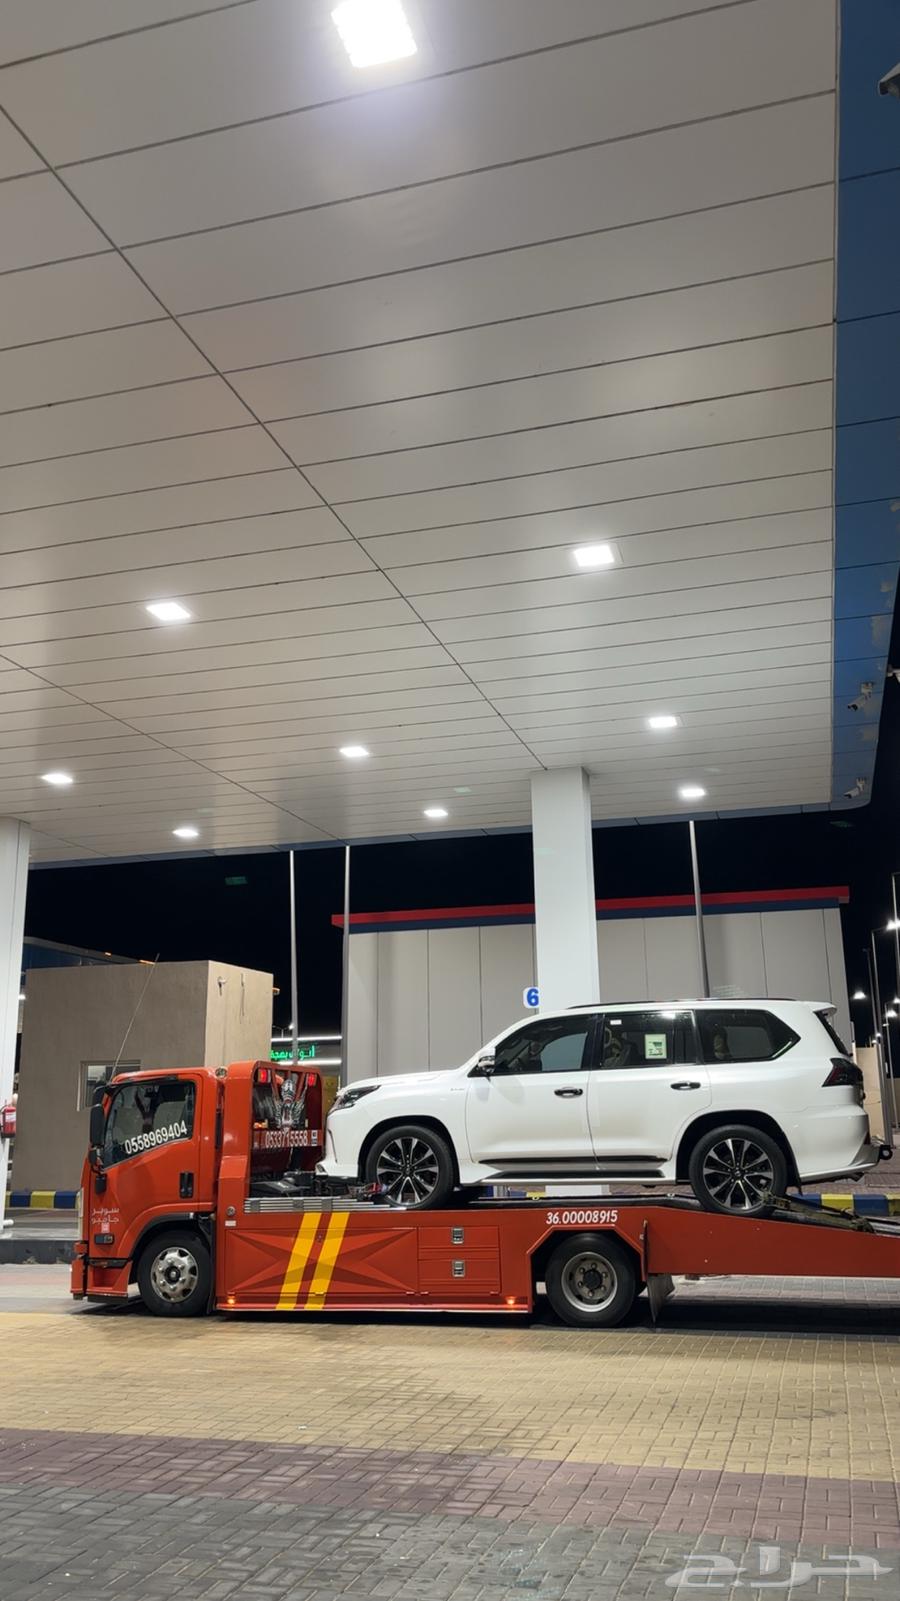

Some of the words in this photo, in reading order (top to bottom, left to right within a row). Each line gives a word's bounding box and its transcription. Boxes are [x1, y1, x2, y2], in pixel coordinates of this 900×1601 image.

[526, 987, 539, 1006] 6
[125, 1120, 187, 1154] 0558969404
[545, 1209, 618, 1225] 36.00008915
